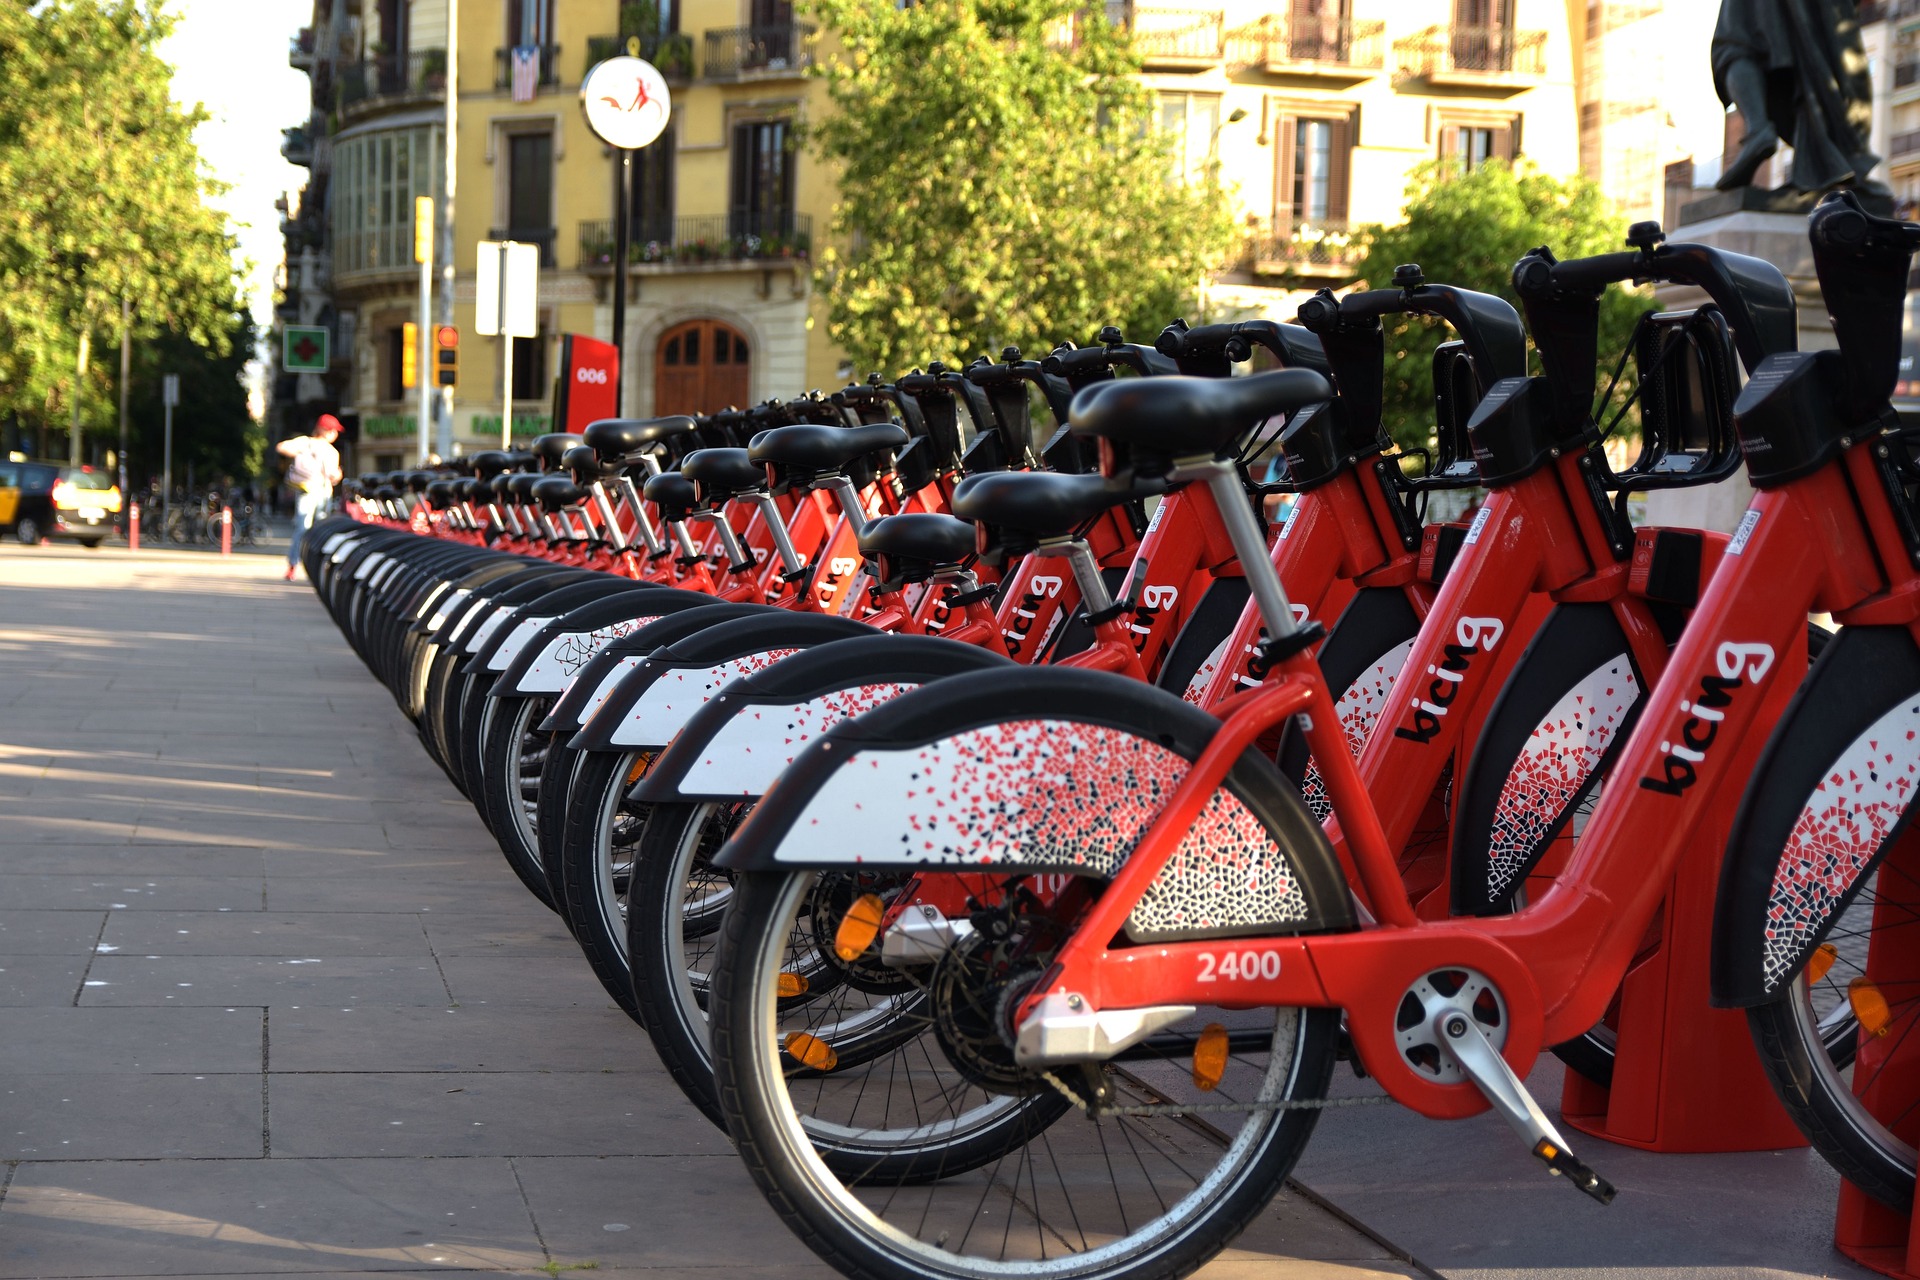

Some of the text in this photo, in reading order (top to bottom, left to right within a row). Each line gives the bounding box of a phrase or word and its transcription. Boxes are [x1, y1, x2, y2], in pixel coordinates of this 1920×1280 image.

[576, 366, 608, 385] 006
[1394, 616, 1504, 744] bicing
[1639, 641, 1775, 797] bicing
[1196, 950, 1281, 983] 2400
